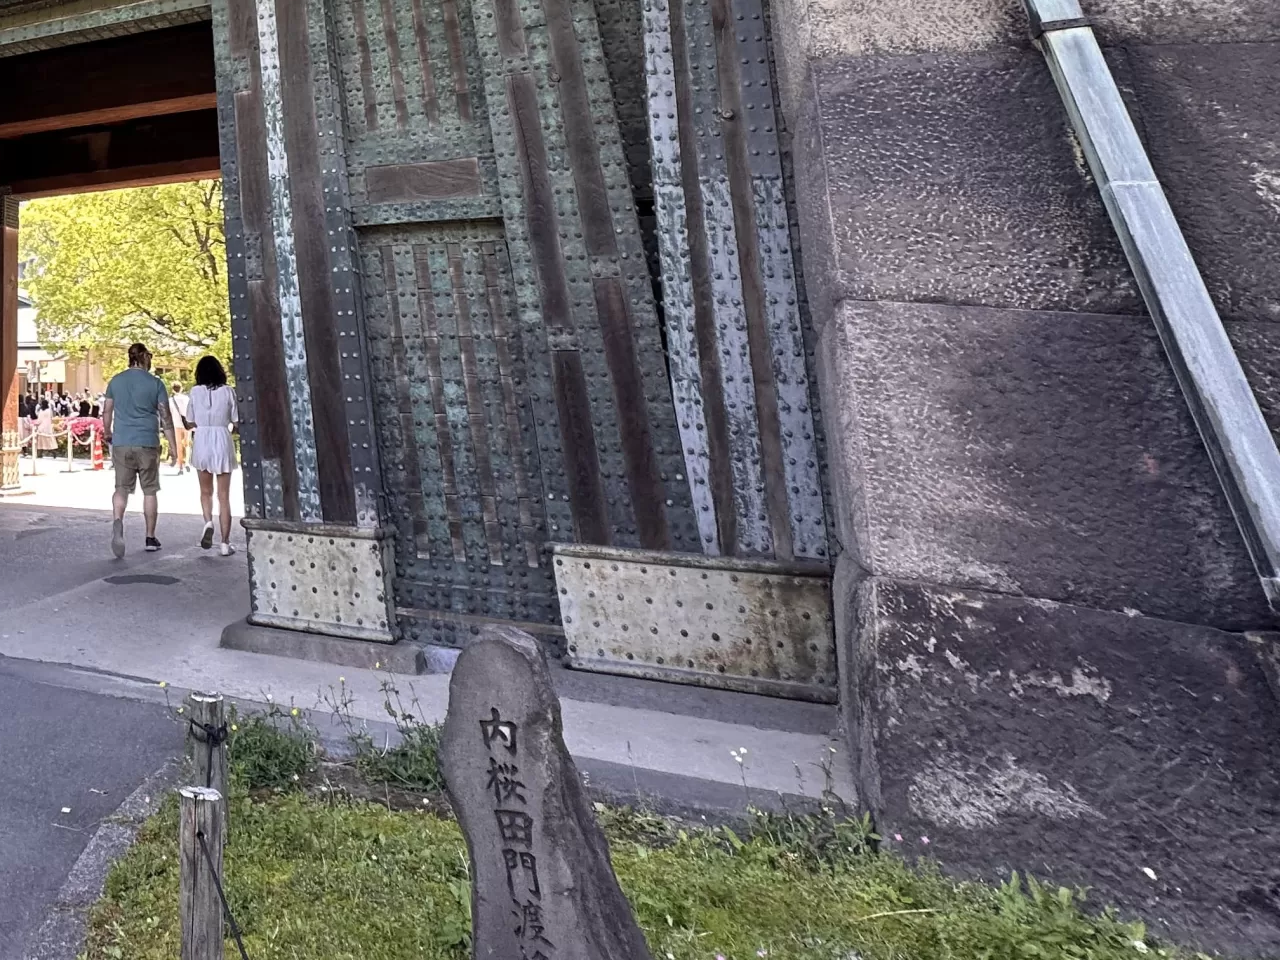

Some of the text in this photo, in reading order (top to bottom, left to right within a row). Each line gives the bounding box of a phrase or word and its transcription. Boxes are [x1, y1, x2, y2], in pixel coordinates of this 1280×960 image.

[479, 707, 556, 960] 内桜田門渡
